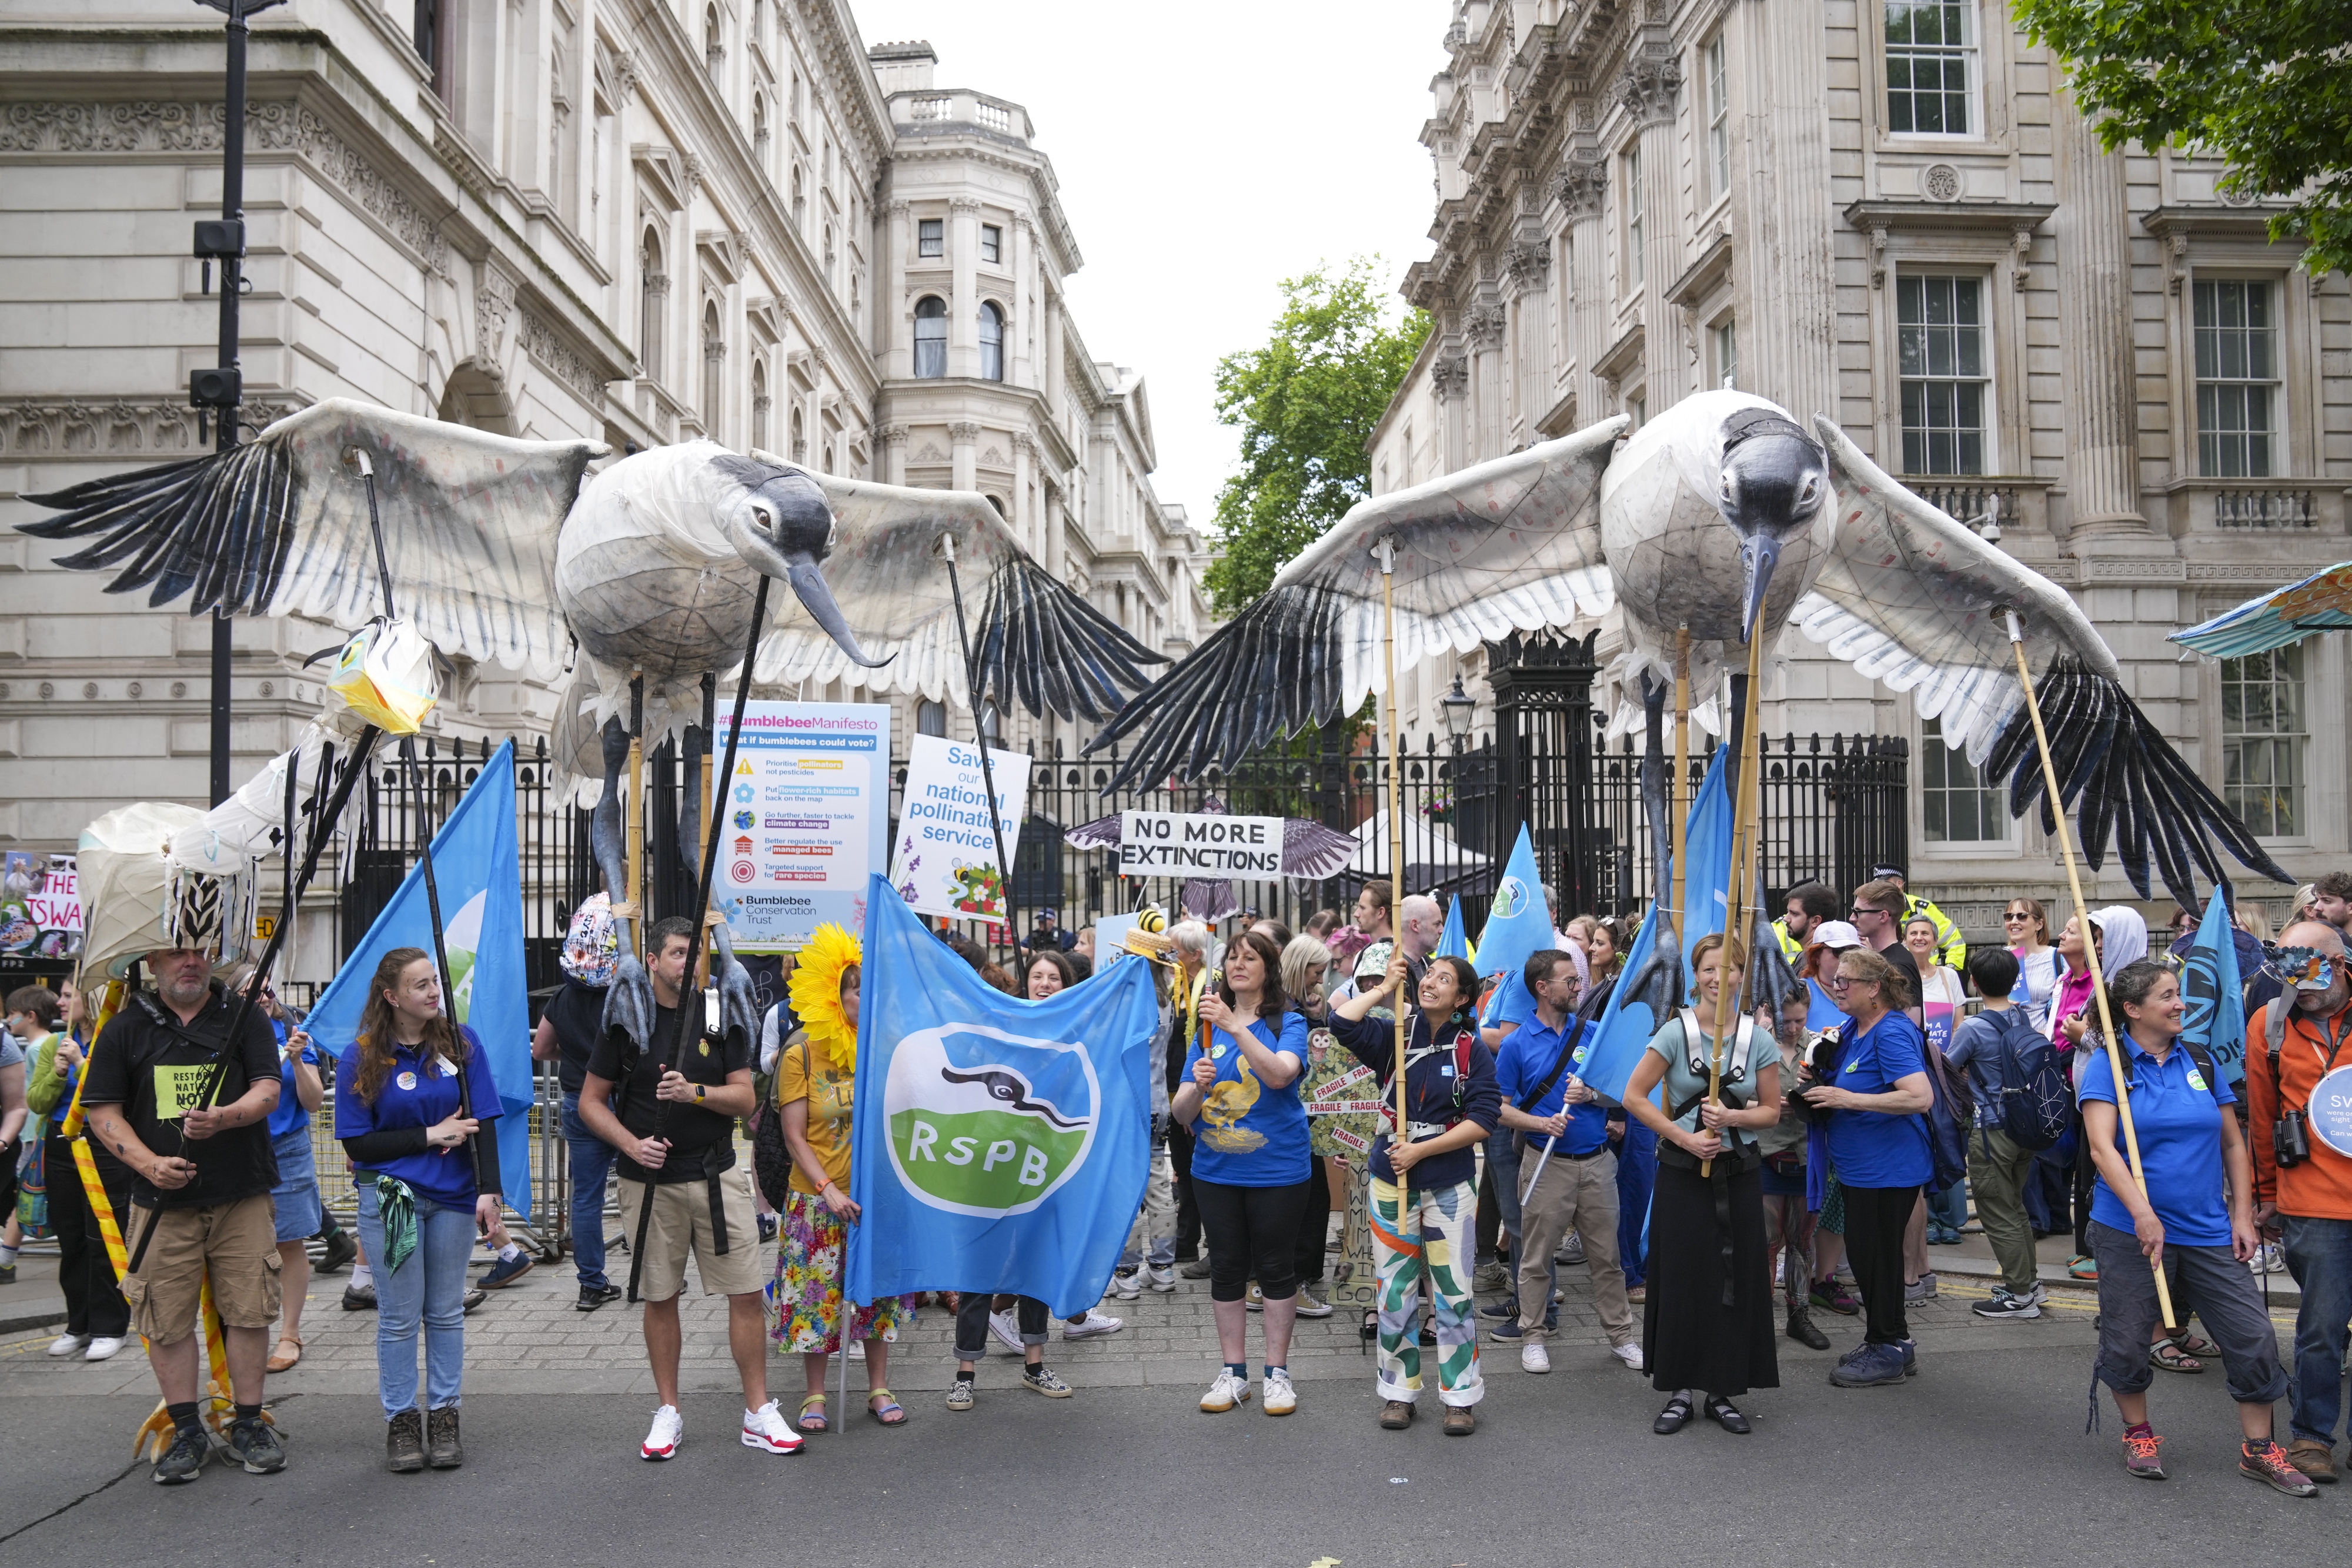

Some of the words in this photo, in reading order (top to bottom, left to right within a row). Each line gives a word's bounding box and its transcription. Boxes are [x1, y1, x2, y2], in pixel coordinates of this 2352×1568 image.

[722, 735, 747, 744] Wat
[759, 737, 817, 745] bumblebees
[799, 761, 842, 769] pollinators
[948, 747, 995, 771] Save
[958, 773, 980, 784] our
[926, 784, 1005, 810] nationl
[923, 825, 993, 849] service
[1135, 818, 1170, 838] NO
[1185, 821, 1264, 844] MORE
[1121, 844, 1279, 871] EXTINCTIONS
[41, 874, 76, 894] THE
[746, 895, 811, 905] Bumblebee
[746, 905, 817, 915] Conservation
[746, 915, 773, 924] Trust
[1317, 1077, 1347, 1098] FRAGILE
[1310, 1103, 1341, 1112] FRAGILE
[1351, 1101, 1382, 1111] FRAGILE
[2331, 1095, 2352, 1108] SW
[1334, 1129, 1365, 1149] FRAGILE
[908, 1119, 1049, 1186] RSPB
[1351, 1165, 1371, 1189] YO
[1350, 1208, 1371, 1226] MI
